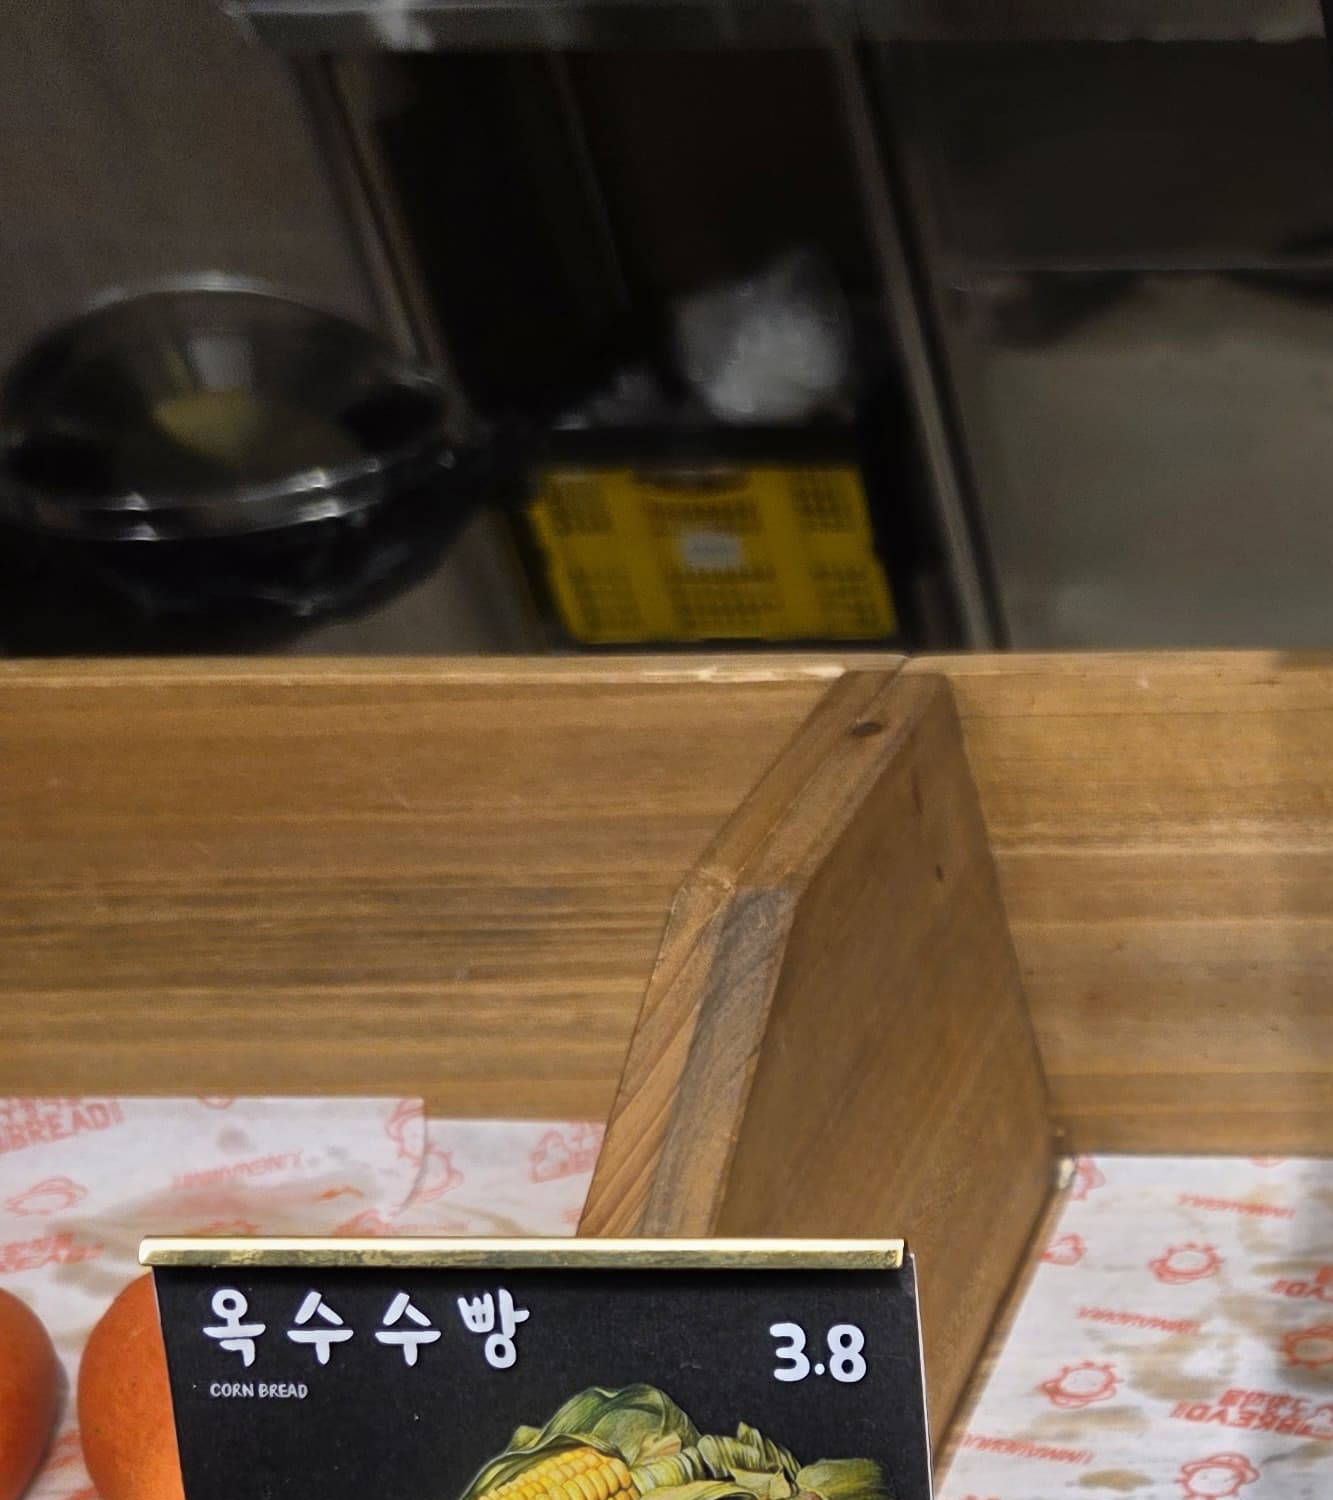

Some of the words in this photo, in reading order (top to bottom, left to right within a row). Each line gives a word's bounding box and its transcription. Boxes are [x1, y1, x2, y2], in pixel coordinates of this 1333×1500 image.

[203, 1288, 530, 1368] 옥수수빵
[769, 1322, 867, 1383] 3.8
[210, 1383, 254, 1399] CORN
[258, 1383, 308, 1399] BREAD
